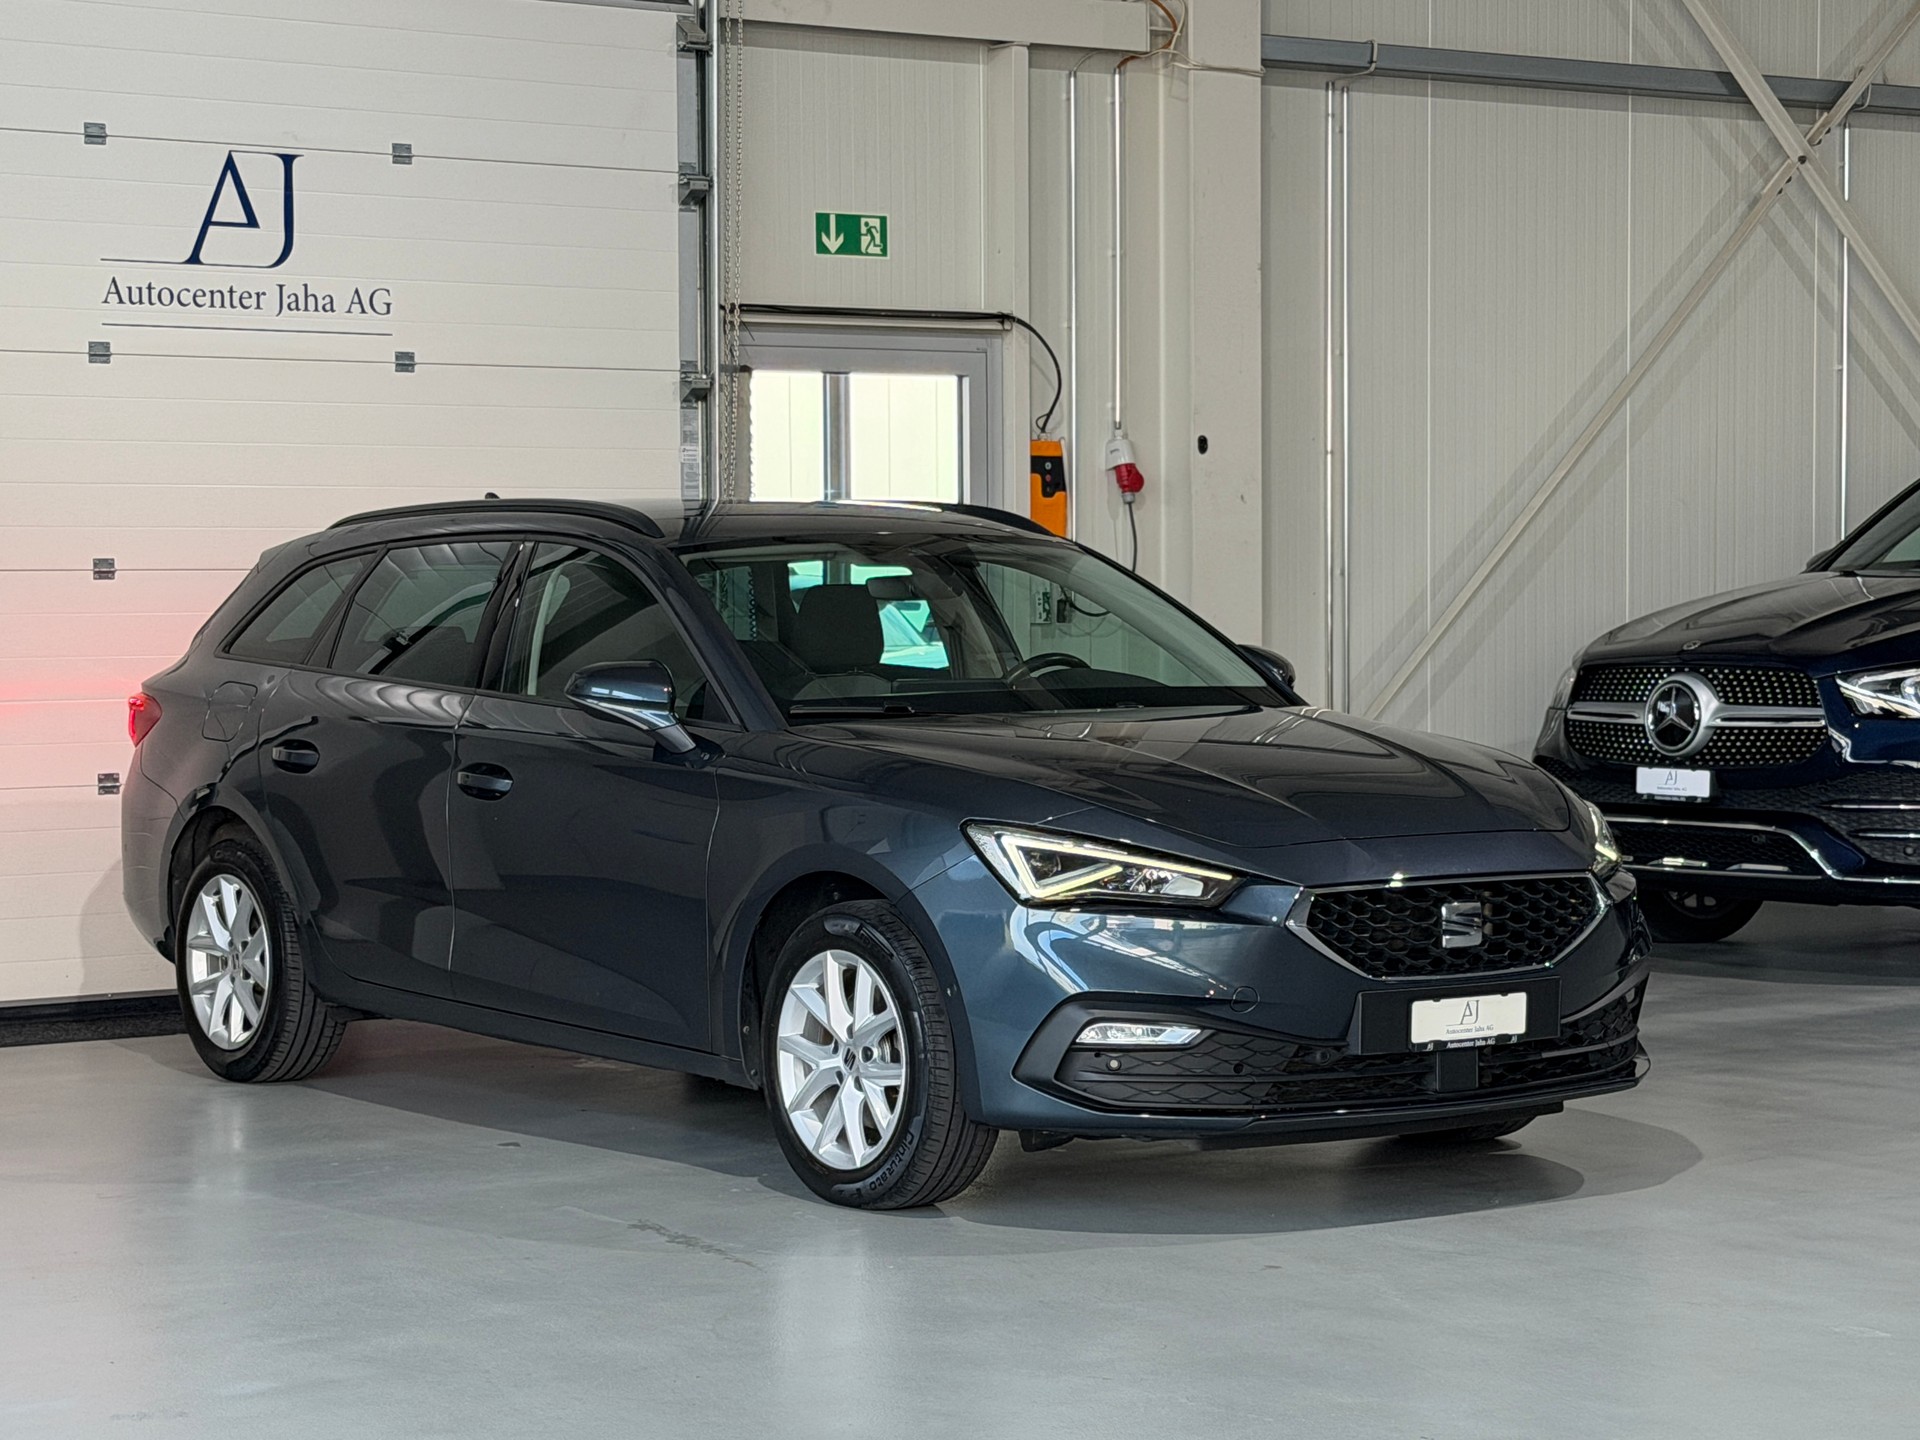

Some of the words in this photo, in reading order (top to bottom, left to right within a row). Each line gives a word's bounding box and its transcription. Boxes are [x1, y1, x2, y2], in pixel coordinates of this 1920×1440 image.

[181, 150, 304, 268] AJ
[101, 276, 267, 311] Autocenter
[275, 283, 337, 317] Jaha
[344, 287, 393, 316] AG
[1459, 999, 1480, 1025] AJ
